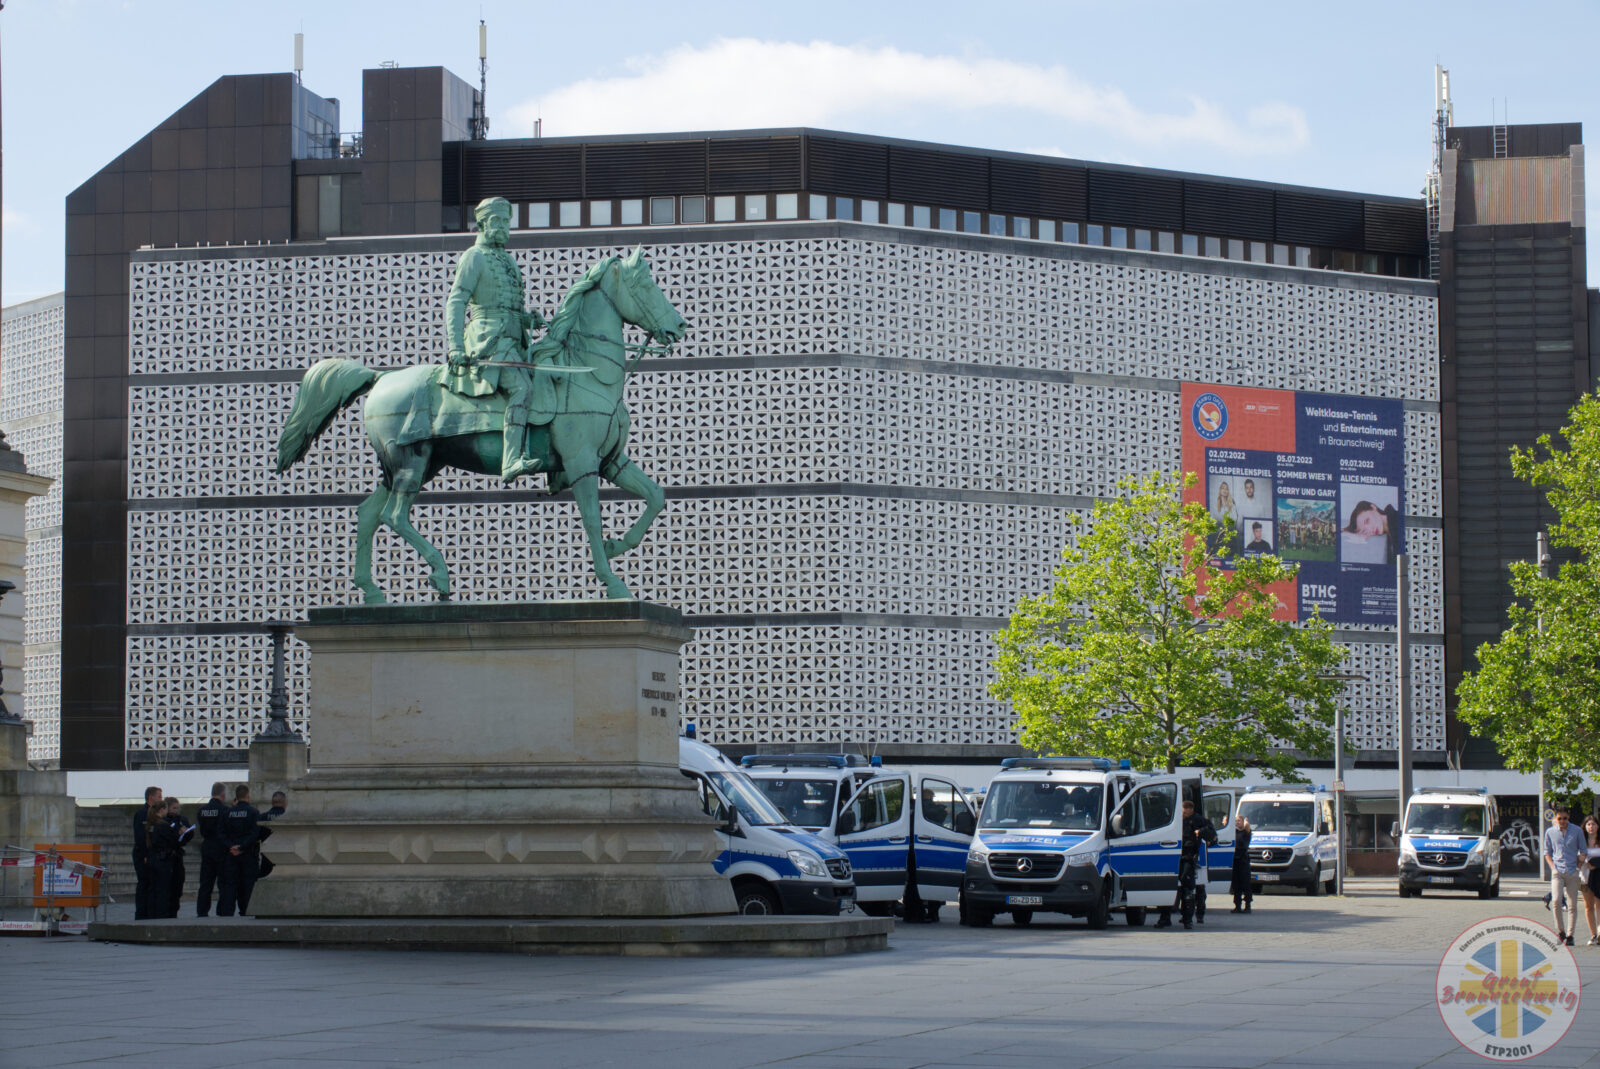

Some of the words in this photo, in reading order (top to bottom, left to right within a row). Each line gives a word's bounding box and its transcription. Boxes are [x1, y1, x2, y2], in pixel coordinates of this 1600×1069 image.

[1305, 406, 1378, 421] Weltklasse-Tennis
[1323, 424, 1339, 432] und
[1340, 423, 1398, 437] Entertainment
[1319, 435, 1327, 445] in
[1327, 436, 1385, 451] Braunschweig!
[1208, 449, 1246, 460] 02.07.2022
[1276, 454, 1313, 465] 05.07.2022
[1339, 458, 1375, 469] 09.07.2022
[1208, 465, 1272, 478] GLASPERLENSPIEL
[1276, 470, 1307, 480] SOMMER
[1340, 474, 1360, 483] ALICE
[1360, 476, 1388, 485] MERTON
[1277, 486, 1300, 496] GERRY
[1301, 487, 1316, 496] UND
[1317, 489, 1337, 498] GARY
[1301, 583, 1337, 599] BTHC
[201, 809, 219, 817] POLIZEI
[229, 810, 248, 818] POLIZEI
[1001, 836, 1058, 845] POLIZEI
[1424, 841, 1462, 849] POLIZEI
